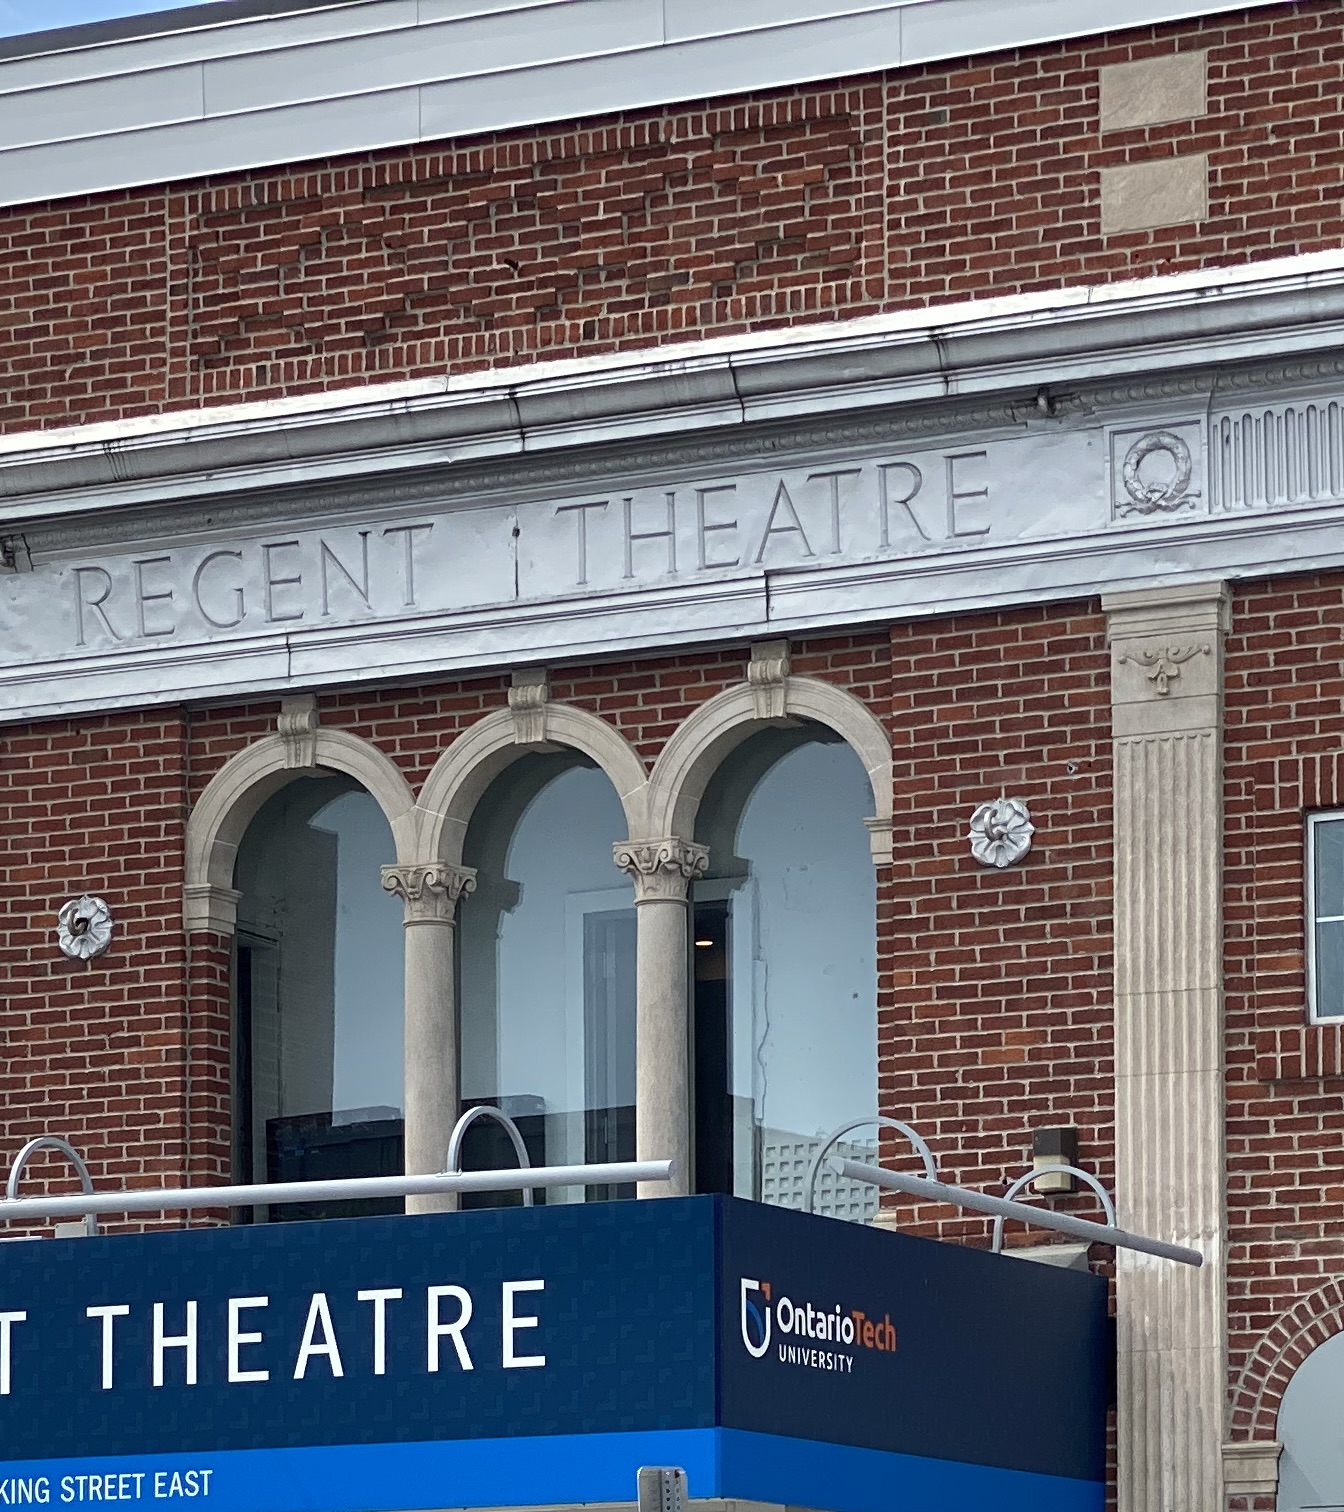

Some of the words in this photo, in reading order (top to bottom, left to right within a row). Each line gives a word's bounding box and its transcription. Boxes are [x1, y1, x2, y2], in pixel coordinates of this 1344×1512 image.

[72, 522, 434, 647] REGENT
[554, 450, 992, 586] THEATRE
[86, 1279, 546, 1391] THEATRE
[778, 1343, 854, 1373] UNIVERSITY
[60, 1472, 145, 1502] STREET
[154, 1469, 213, 1498] EAST
